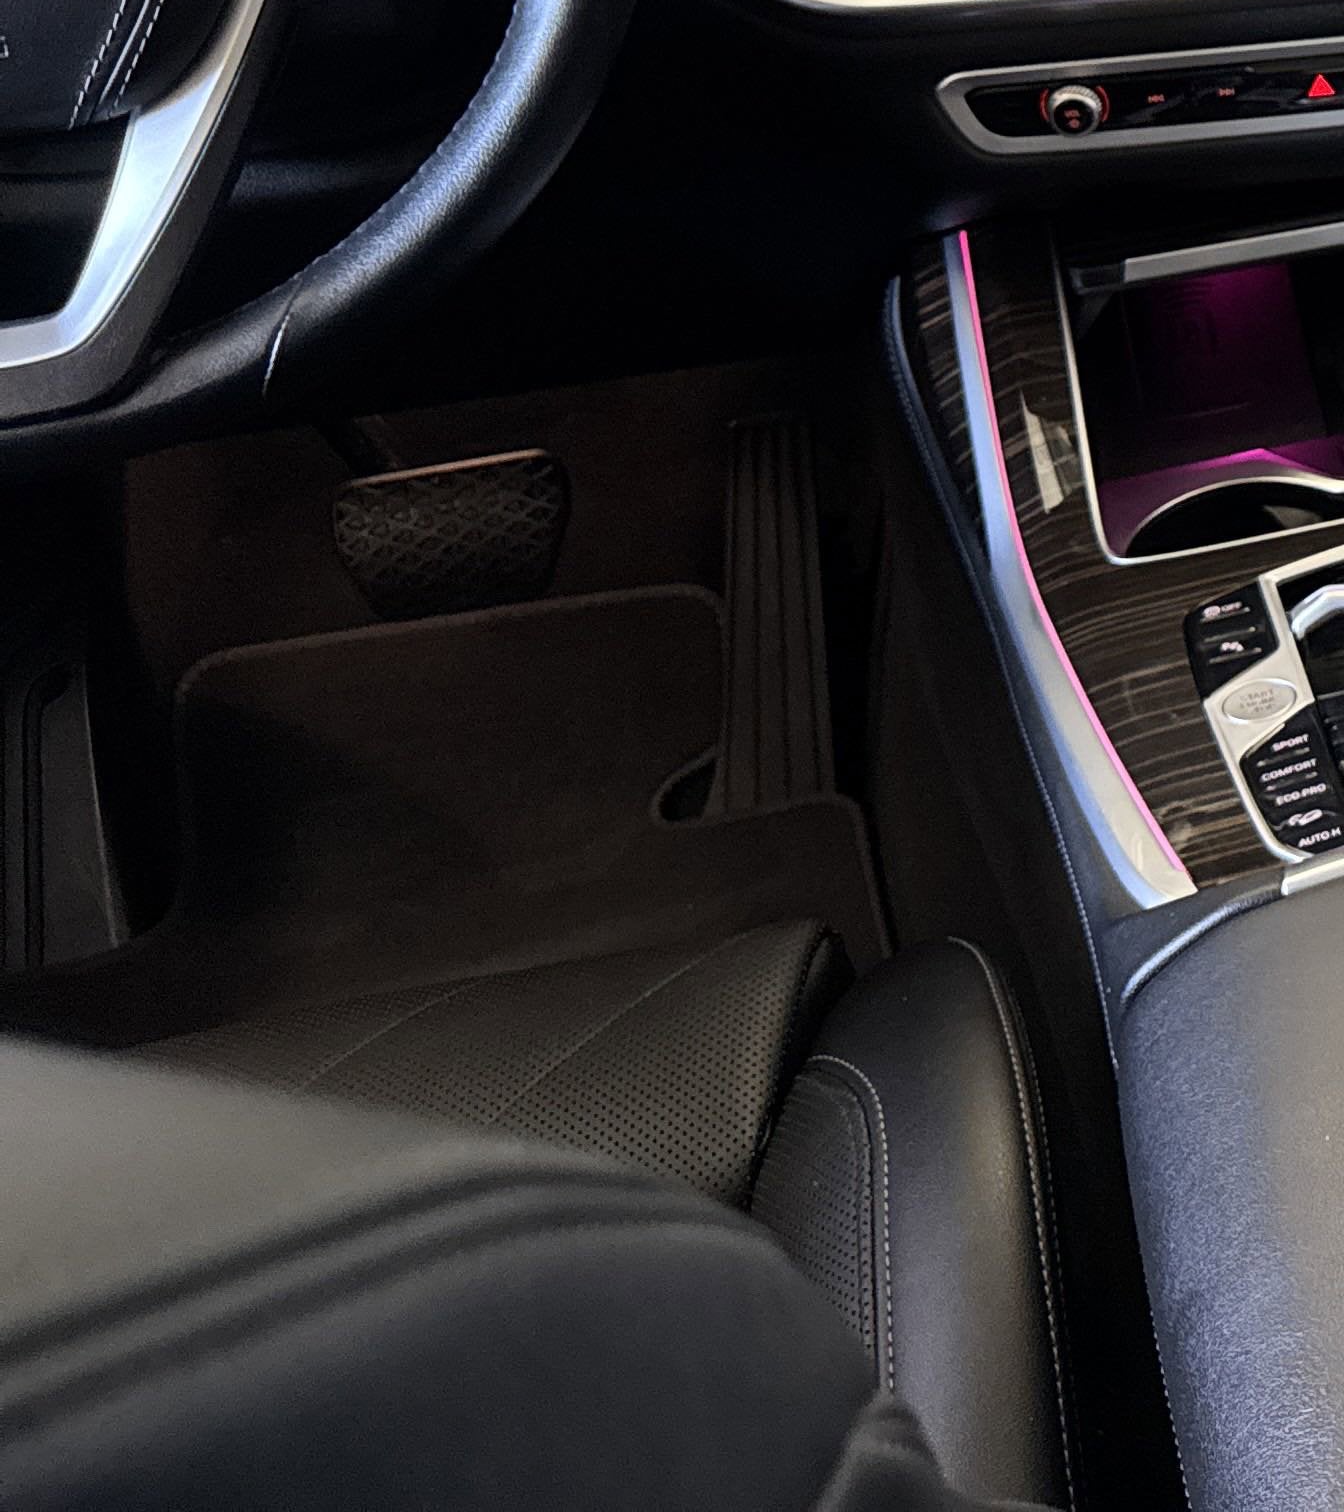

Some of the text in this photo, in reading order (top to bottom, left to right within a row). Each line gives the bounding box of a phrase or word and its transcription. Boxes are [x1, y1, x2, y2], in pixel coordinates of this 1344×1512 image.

[1271, 733, 1310, 753] SPORT
[1260, 757, 1318, 782] COMFORT
[1275, 782, 1328, 807] ECO PRO
[1297, 830, 1330, 848] AUTO
